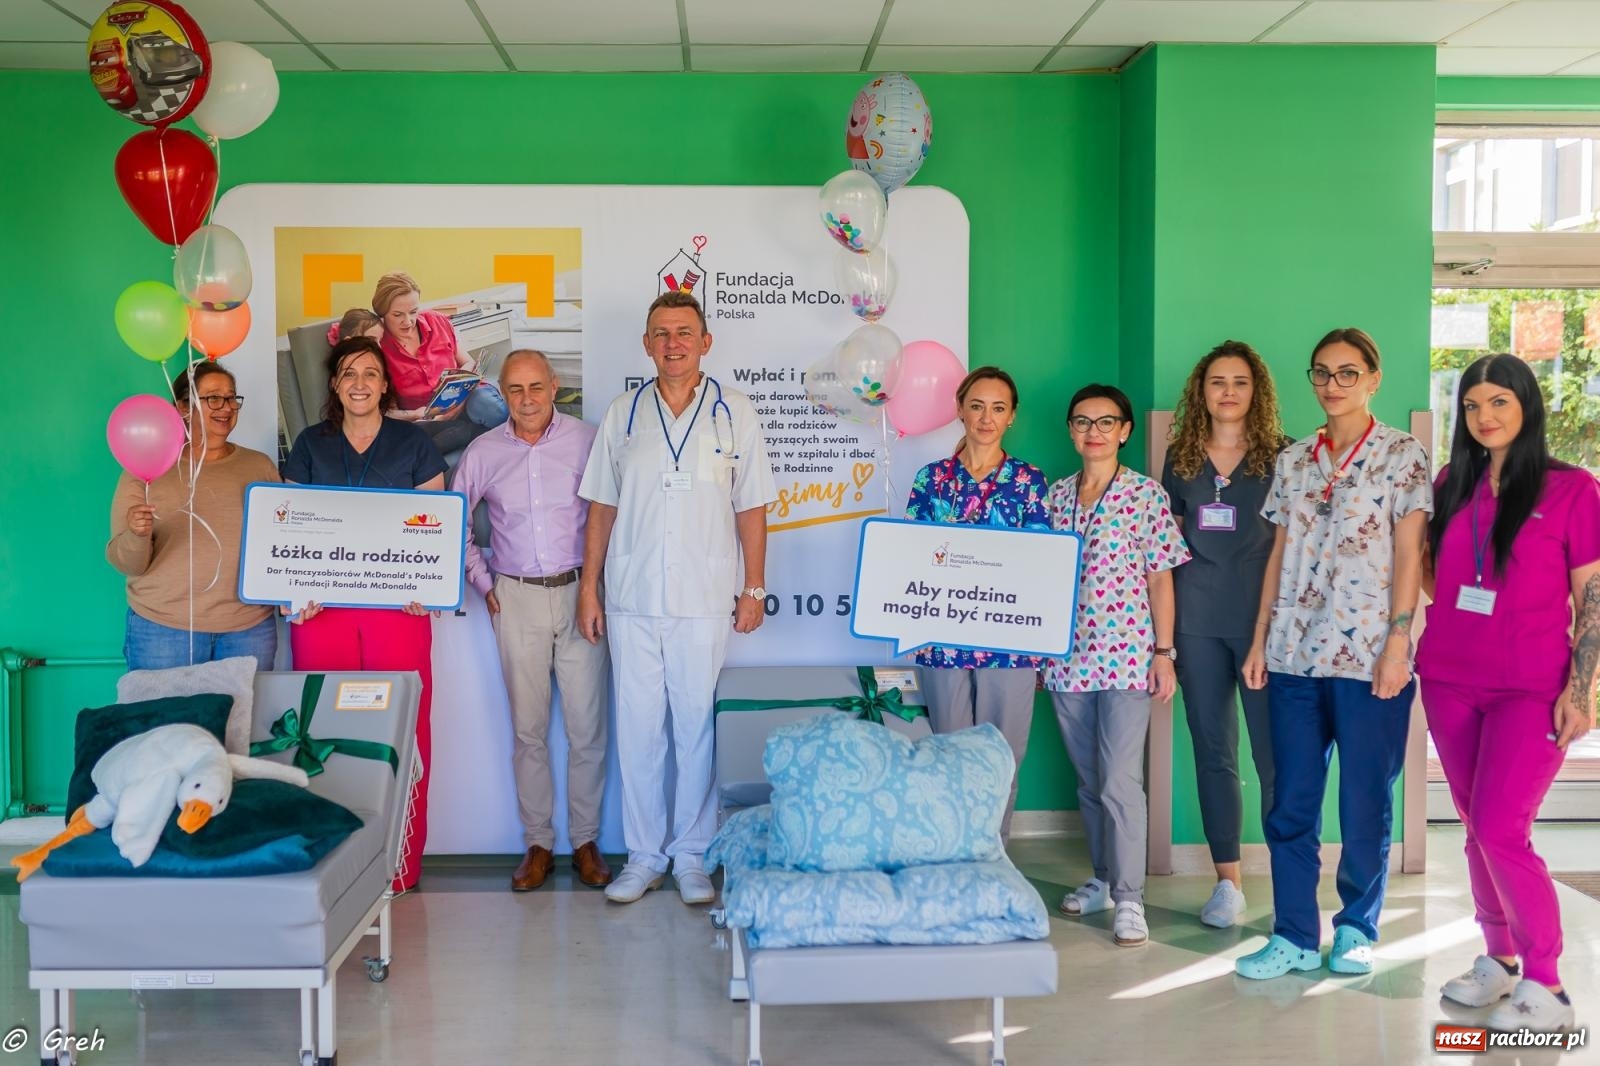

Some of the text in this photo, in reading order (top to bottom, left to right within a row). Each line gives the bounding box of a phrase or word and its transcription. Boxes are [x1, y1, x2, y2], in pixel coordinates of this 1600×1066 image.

[716, 272, 794, 289] Fundacja
[716, 290, 788, 305] Ronalda
[716, 309, 755, 319] Polska
[733, 368, 784, 385] Wpłać
[790, 368, 795, 382] i
[755, 406, 776, 416] oże
[779, 406, 809, 418] kupić
[767, 421, 784, 430] dla
[788, 420, 838, 430] rodziców
[823, 435, 859, 444] swoim
[784, 451, 795, 459] w
[798, 449, 839, 461] szpitalu
[842, 449, 846, 459] i
[849, 449, 876, 459] dbać
[784, 464, 834, 473] Rodzinne
[402, 527, 442, 536] złoty sąsiad
[271, 545, 441, 565] Łóżka dla rodziców
[266, 566, 443, 581] Dar franczyzobiorców McDonald's Polska
[294, 579, 330, 590] Fundacji
[332, 580, 368, 590] Ronalda
[370, 582, 418, 592] McDonalda
[904, 581, 1017, 605] Aby rodzina
[793, 594, 824, 616] 10
[882, 600, 1043, 627] mogła być razem
